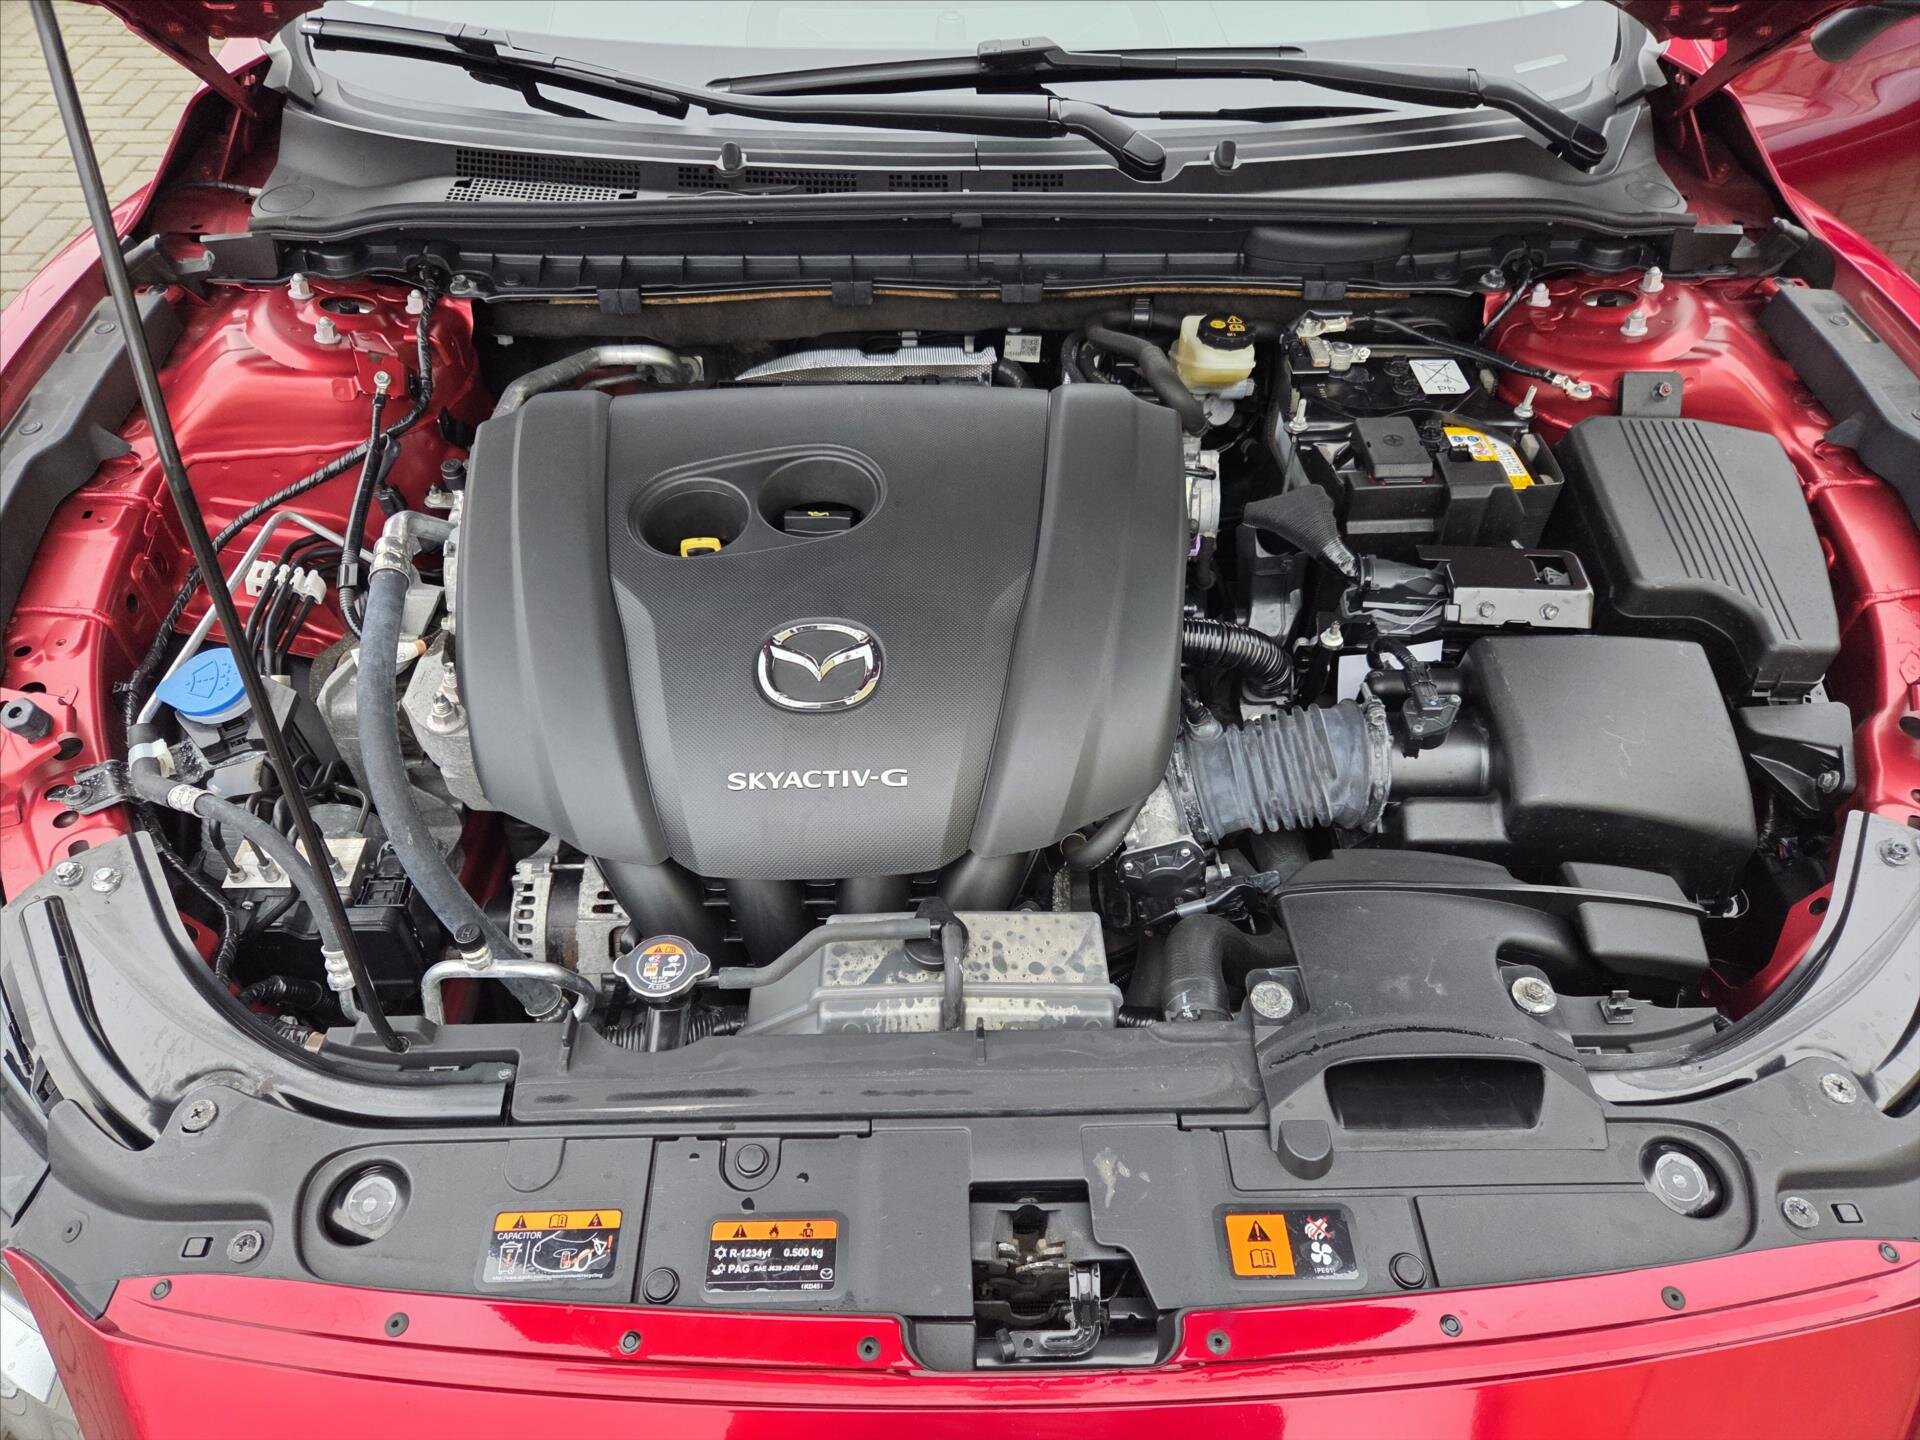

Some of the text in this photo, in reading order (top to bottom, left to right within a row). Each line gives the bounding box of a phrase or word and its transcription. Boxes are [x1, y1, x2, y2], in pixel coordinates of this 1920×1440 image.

[1437, 385, 1456, 393] Pb
[727, 768, 909, 791] SKYACTIV-G
[497, 1231, 542, 1241] CAPACITOR
[729, 1247, 824, 1259] R-1234yf 0.500 kg
[728, 1263, 750, 1274] PAG
